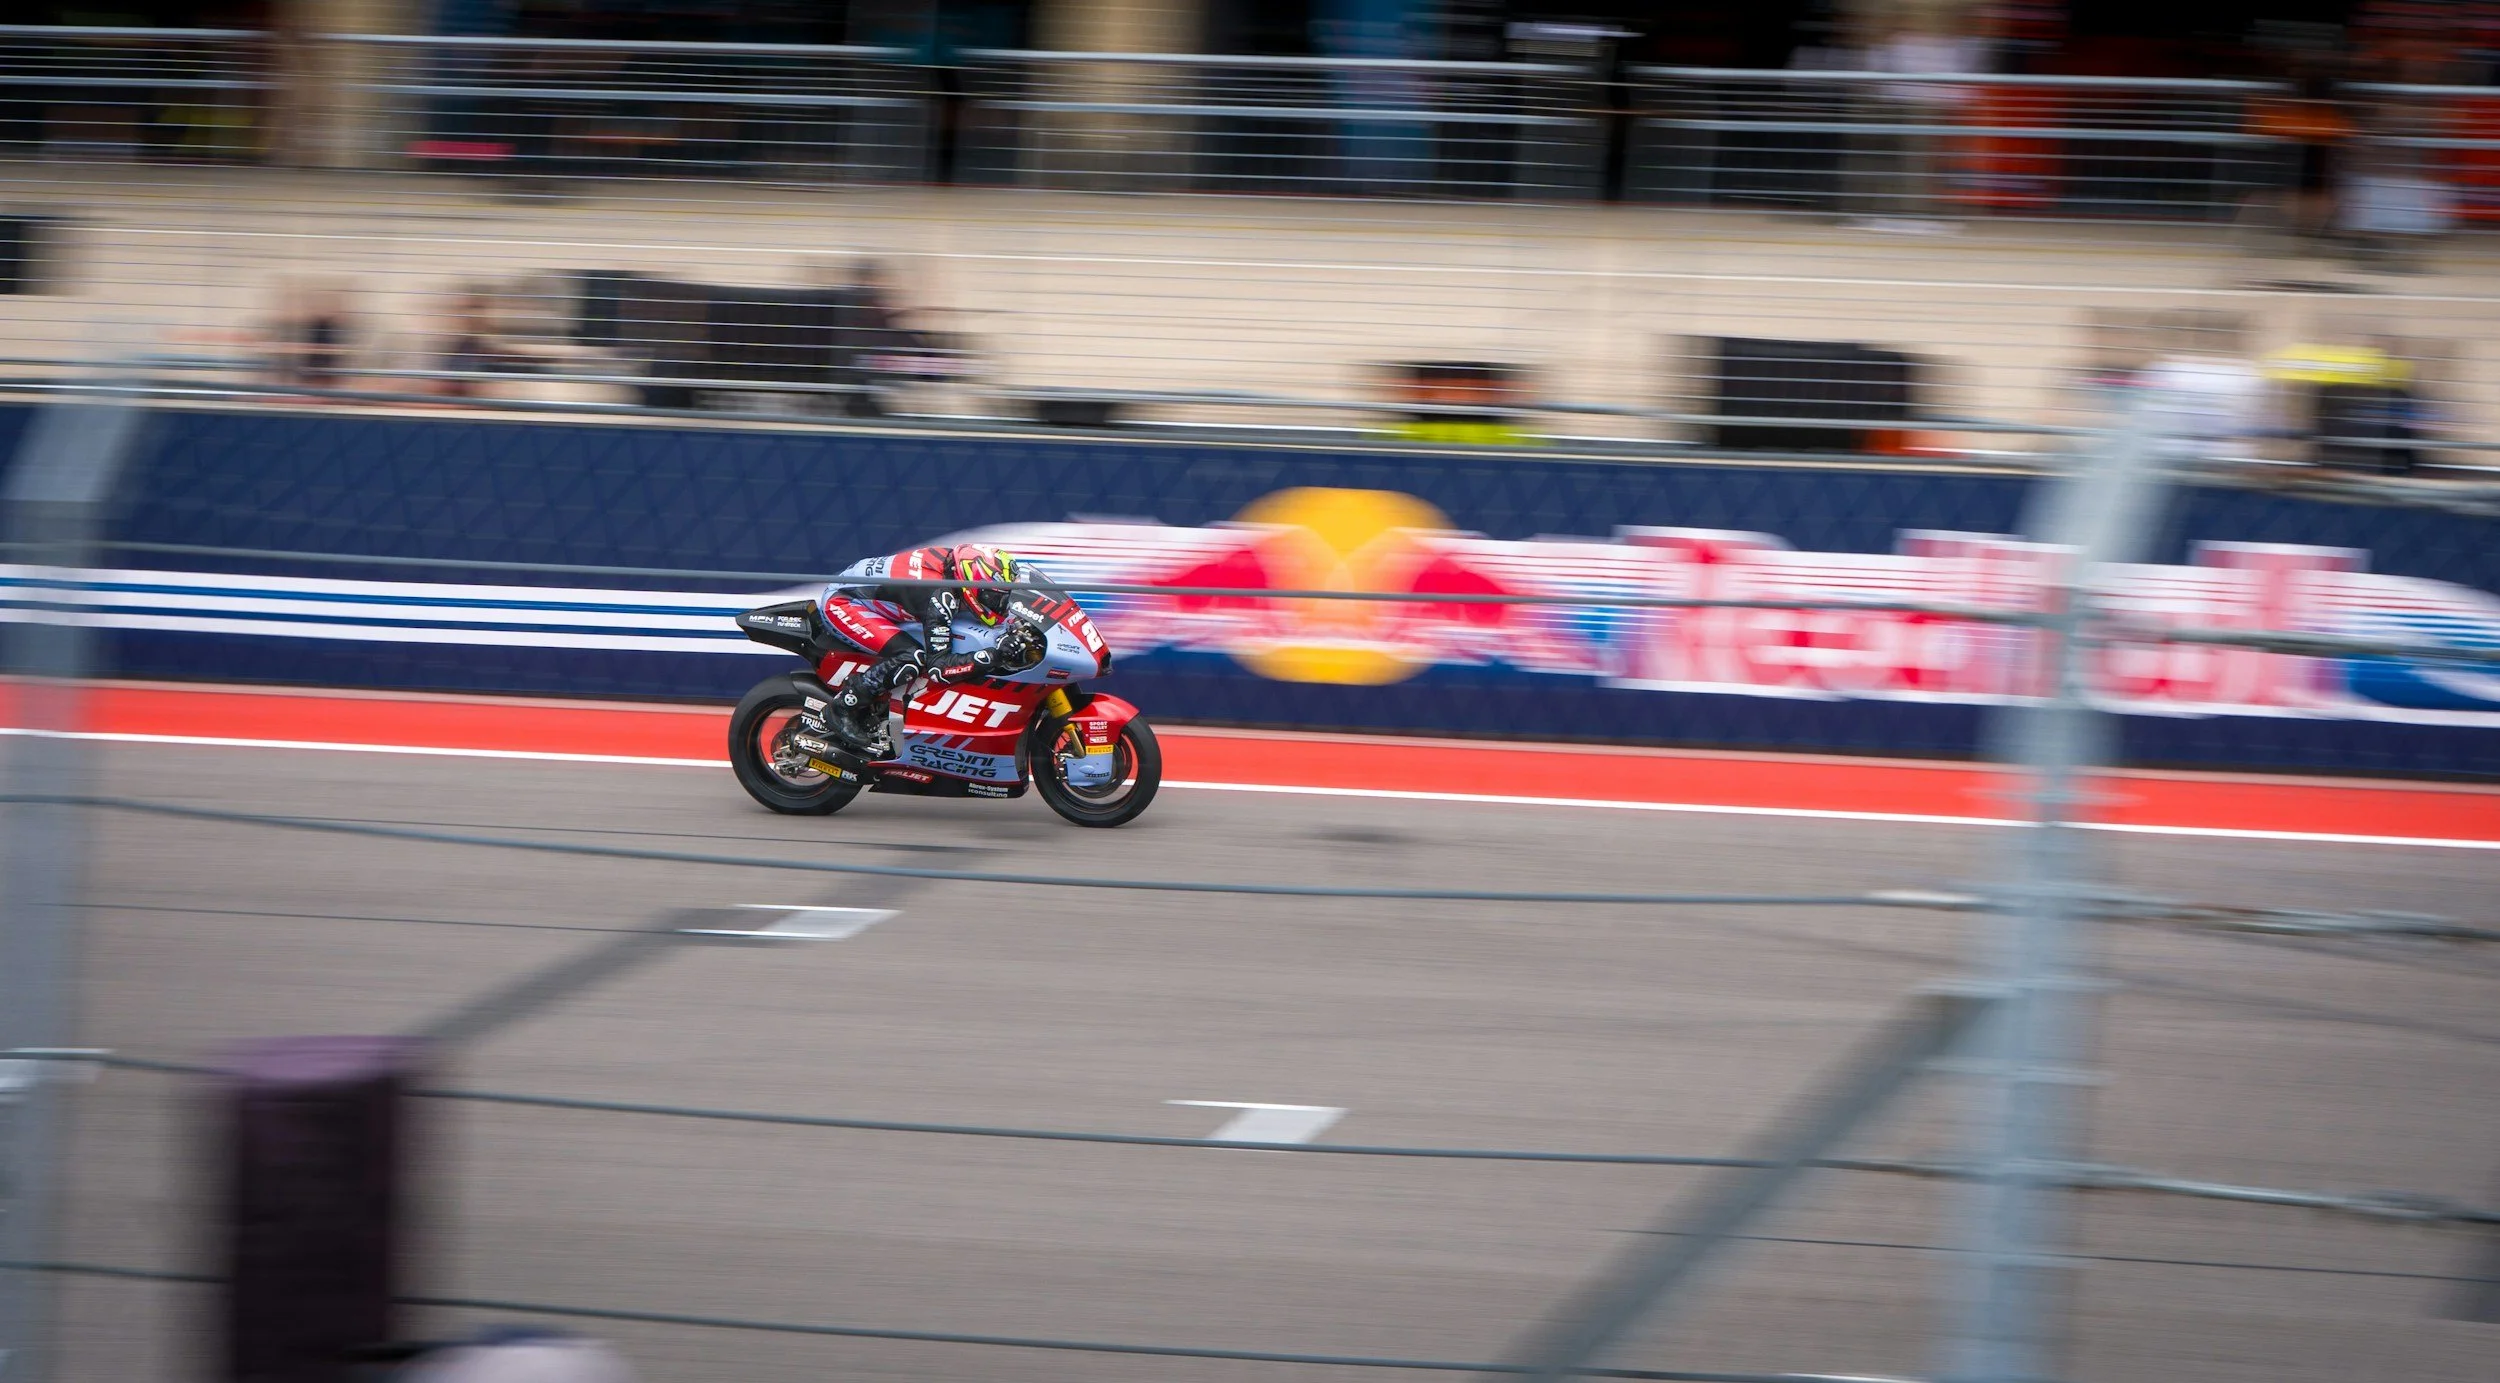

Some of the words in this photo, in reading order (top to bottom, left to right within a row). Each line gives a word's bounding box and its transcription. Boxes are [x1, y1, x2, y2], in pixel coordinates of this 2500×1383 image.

[1081, 620, 1104, 653] 2
[945, 666, 972, 675] ITALJET
[910, 744, 996, 767] GRESINI
[911, 755, 997, 778] RACING
[884, 769, 930, 781] ITALJET
